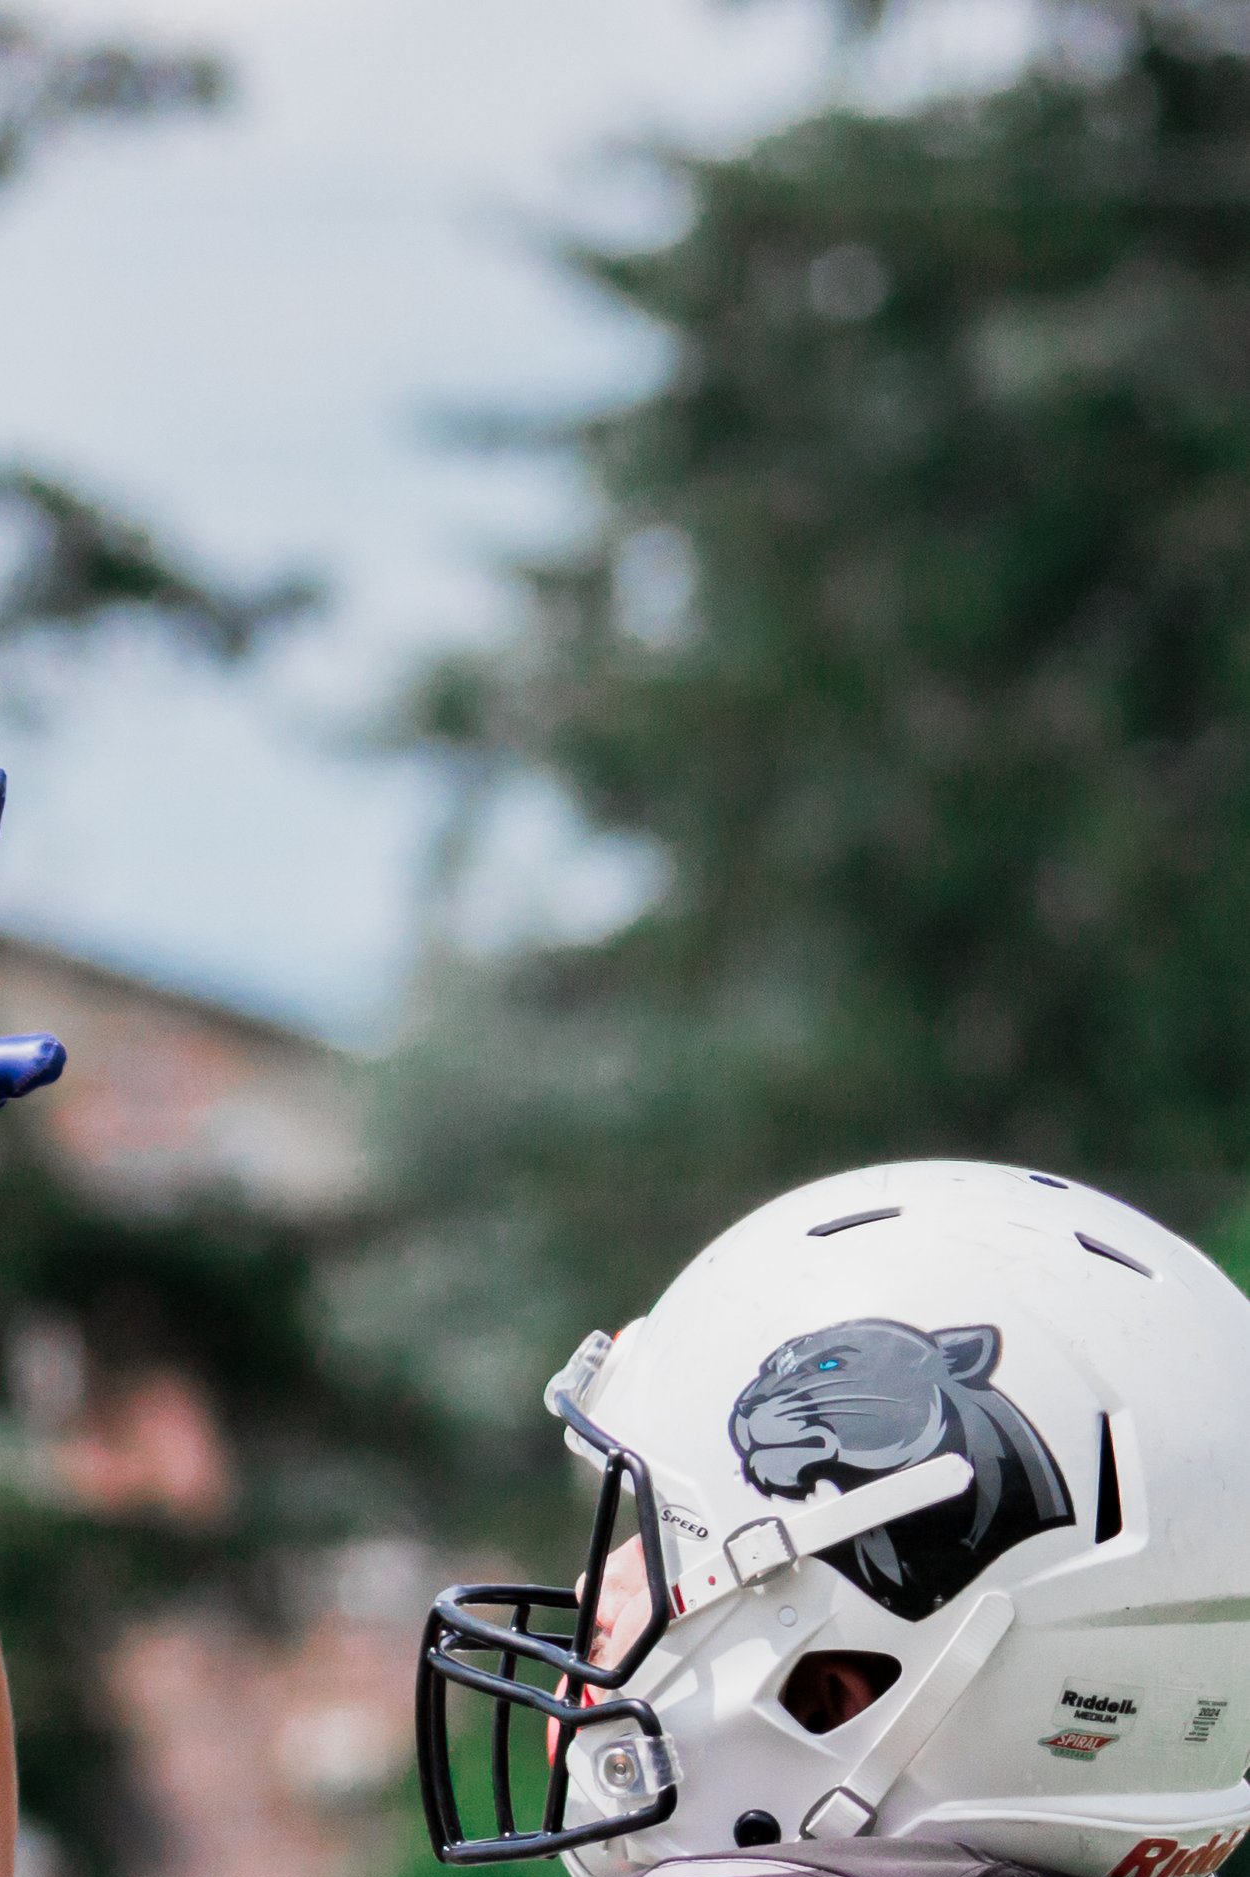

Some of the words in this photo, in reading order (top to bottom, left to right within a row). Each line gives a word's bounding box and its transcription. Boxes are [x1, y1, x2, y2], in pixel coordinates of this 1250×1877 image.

[661, 1509, 709, 1538] SPEED
[1060, 1690, 1134, 1714] Riddell
[1073, 1710, 1117, 1724] MEDIUM
[1056, 1734, 1100, 1750] SPIRAL
